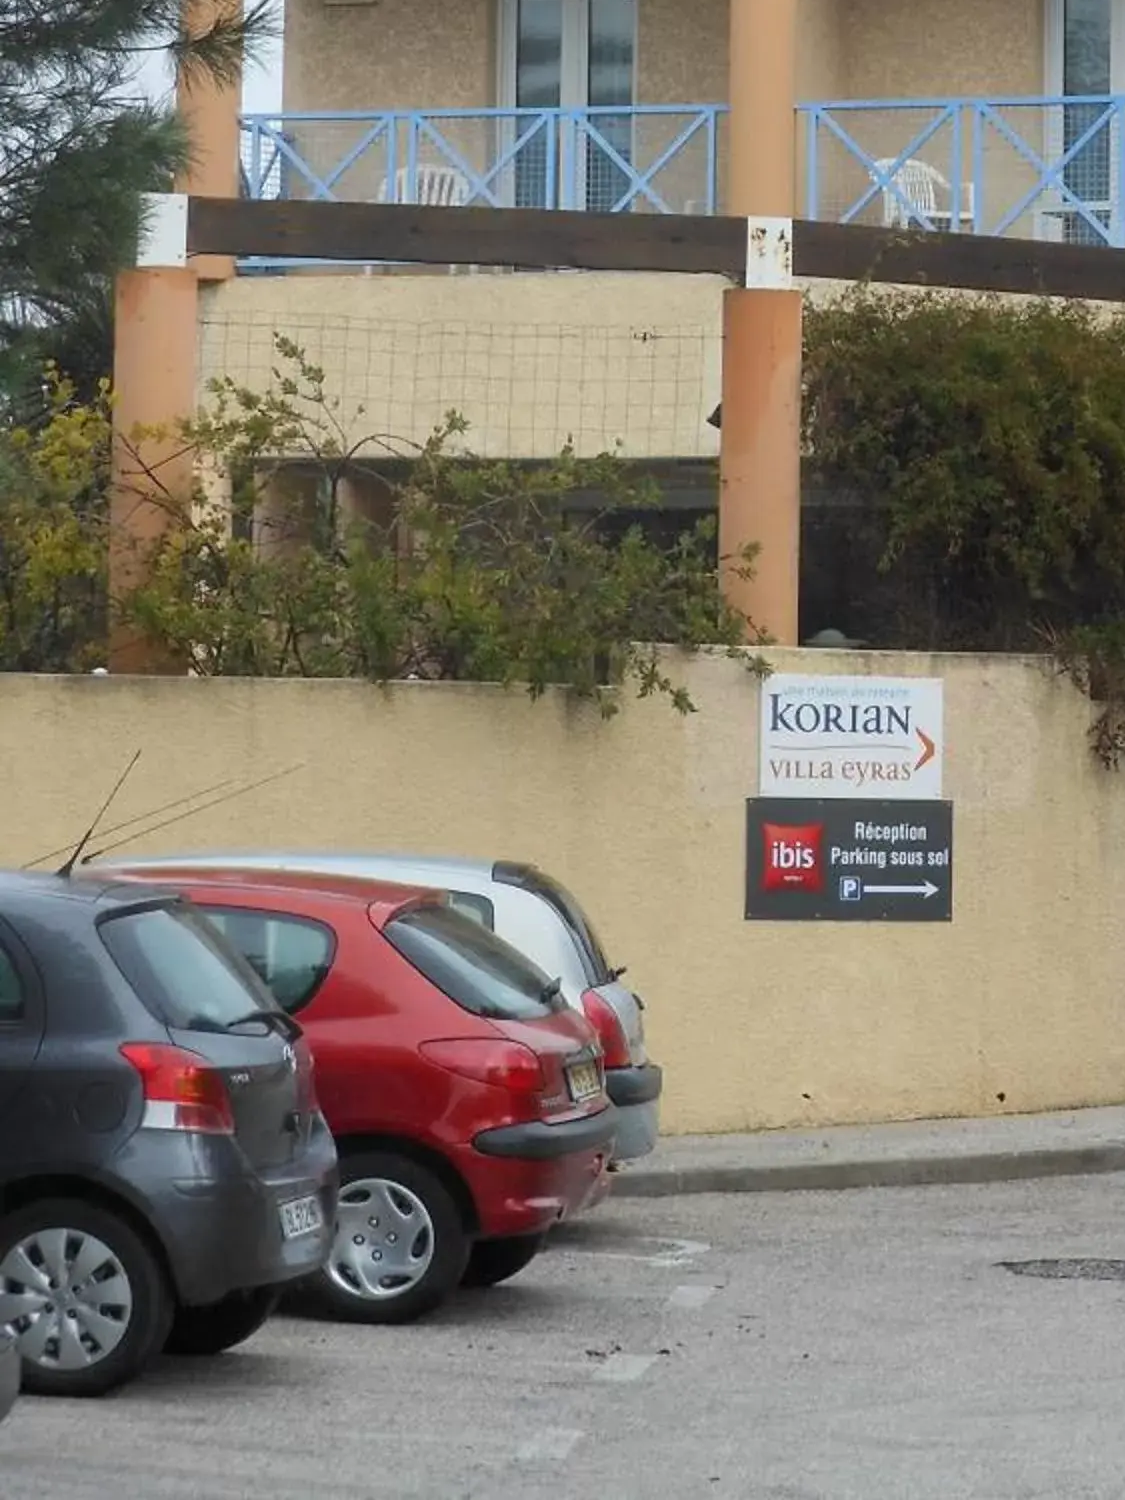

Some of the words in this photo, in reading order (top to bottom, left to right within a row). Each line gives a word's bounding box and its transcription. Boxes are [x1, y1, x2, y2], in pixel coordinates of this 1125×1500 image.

[854, 821, 927, 845] Réception
[772, 841, 815, 869] ibis
[831, 847, 887, 869] Parking
[891, 850, 923, 866] sous
[927, 848, 949, 866] sol
